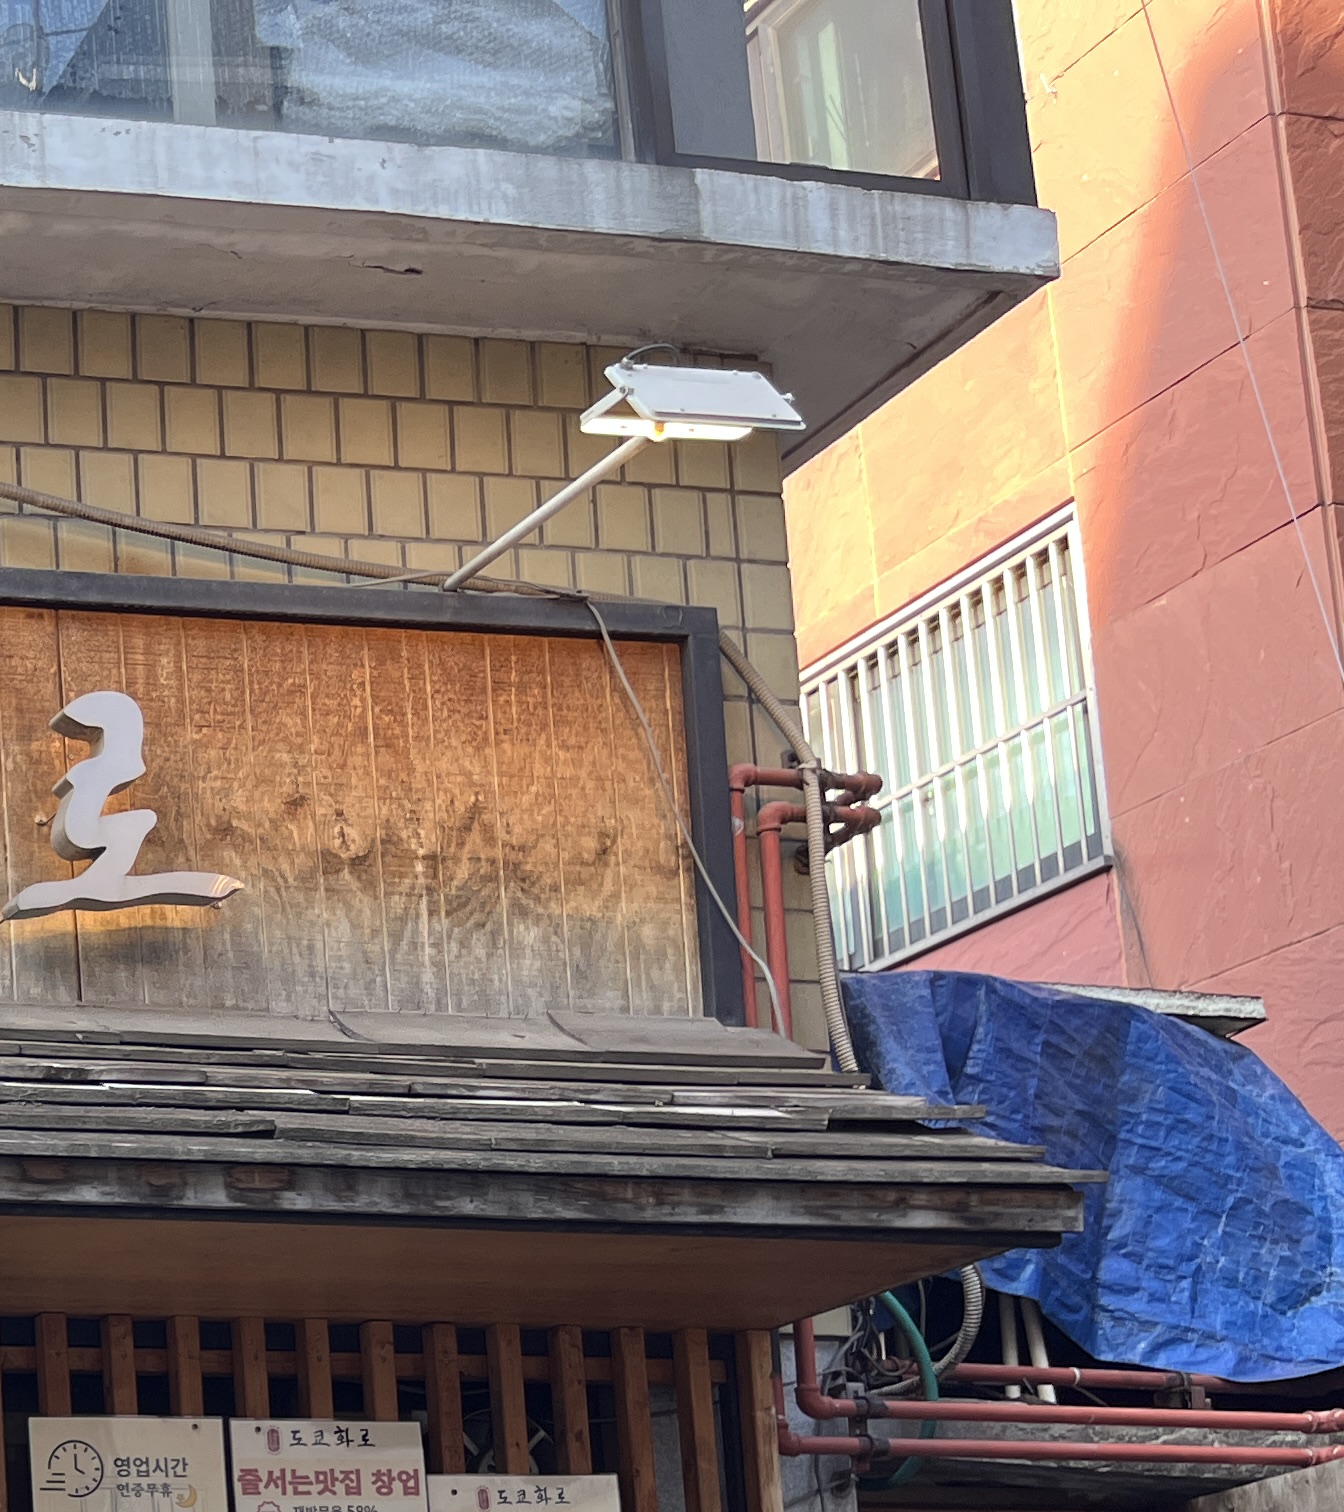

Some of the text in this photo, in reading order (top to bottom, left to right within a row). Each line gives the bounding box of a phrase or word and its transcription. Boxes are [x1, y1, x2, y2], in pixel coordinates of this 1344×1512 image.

[114, 1457, 189, 1478] 영업시간
[117, 1483, 173, 1498] 연중무휴
[371, 1469, 420, 1497] 창업
